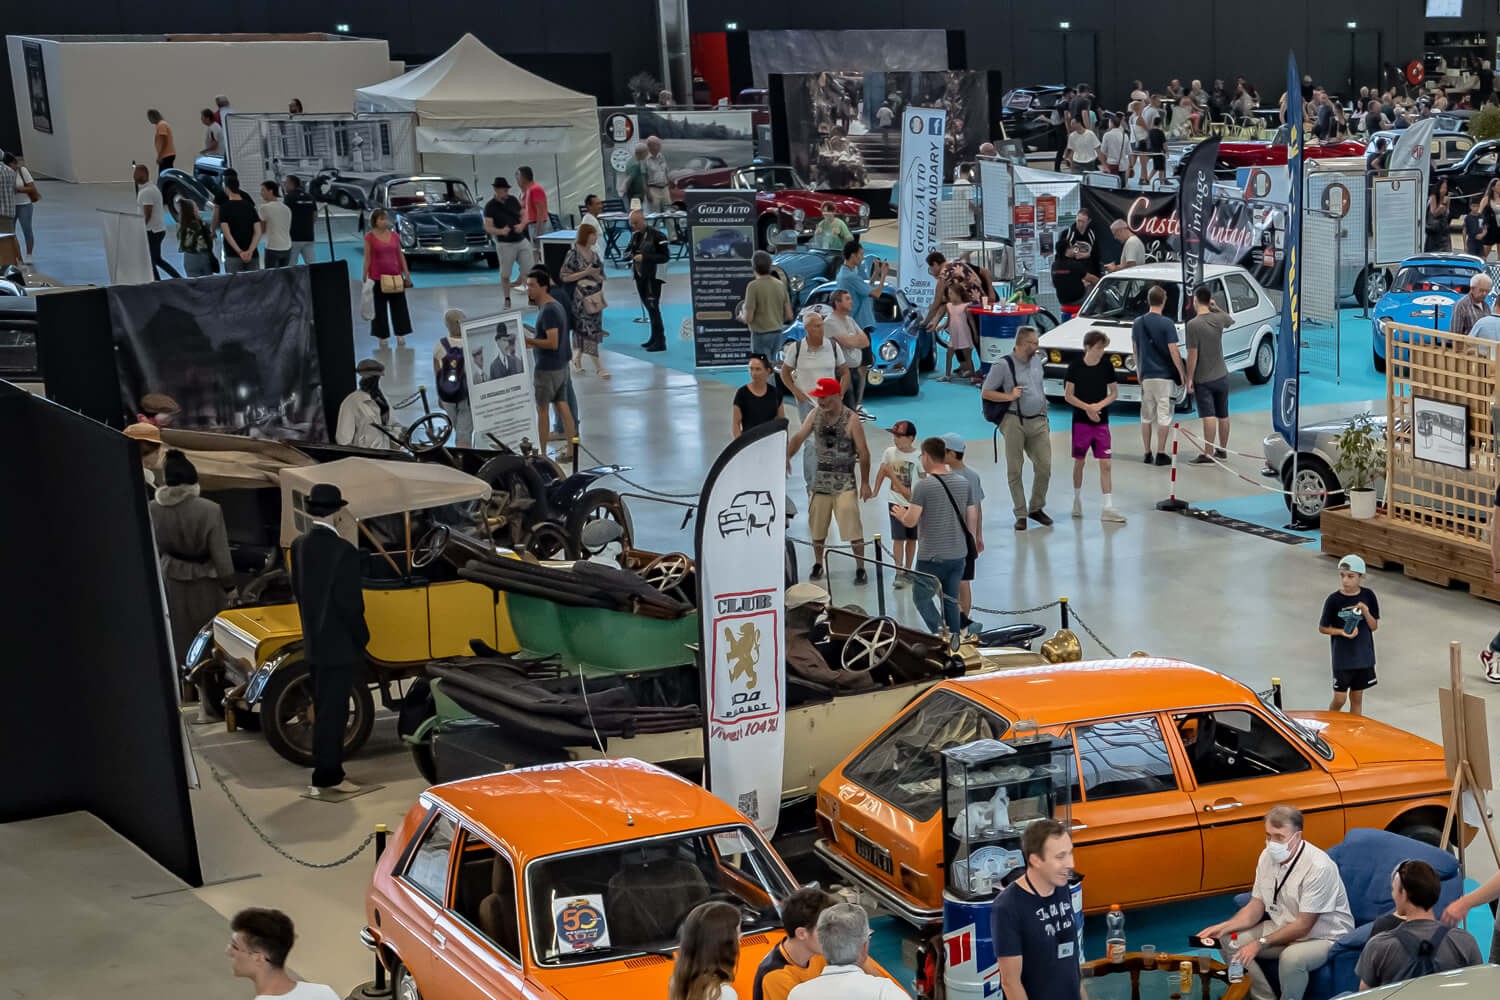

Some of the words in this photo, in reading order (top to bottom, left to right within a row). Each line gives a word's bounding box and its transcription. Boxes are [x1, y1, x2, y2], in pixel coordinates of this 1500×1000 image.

[914, 162, 927, 204] AUTO
[698, 204, 724, 215] GOLD
[725, 204, 750, 215] AUTO
[912, 210, 926, 254] GOLD
[717, 594, 773, 614] CLUB
